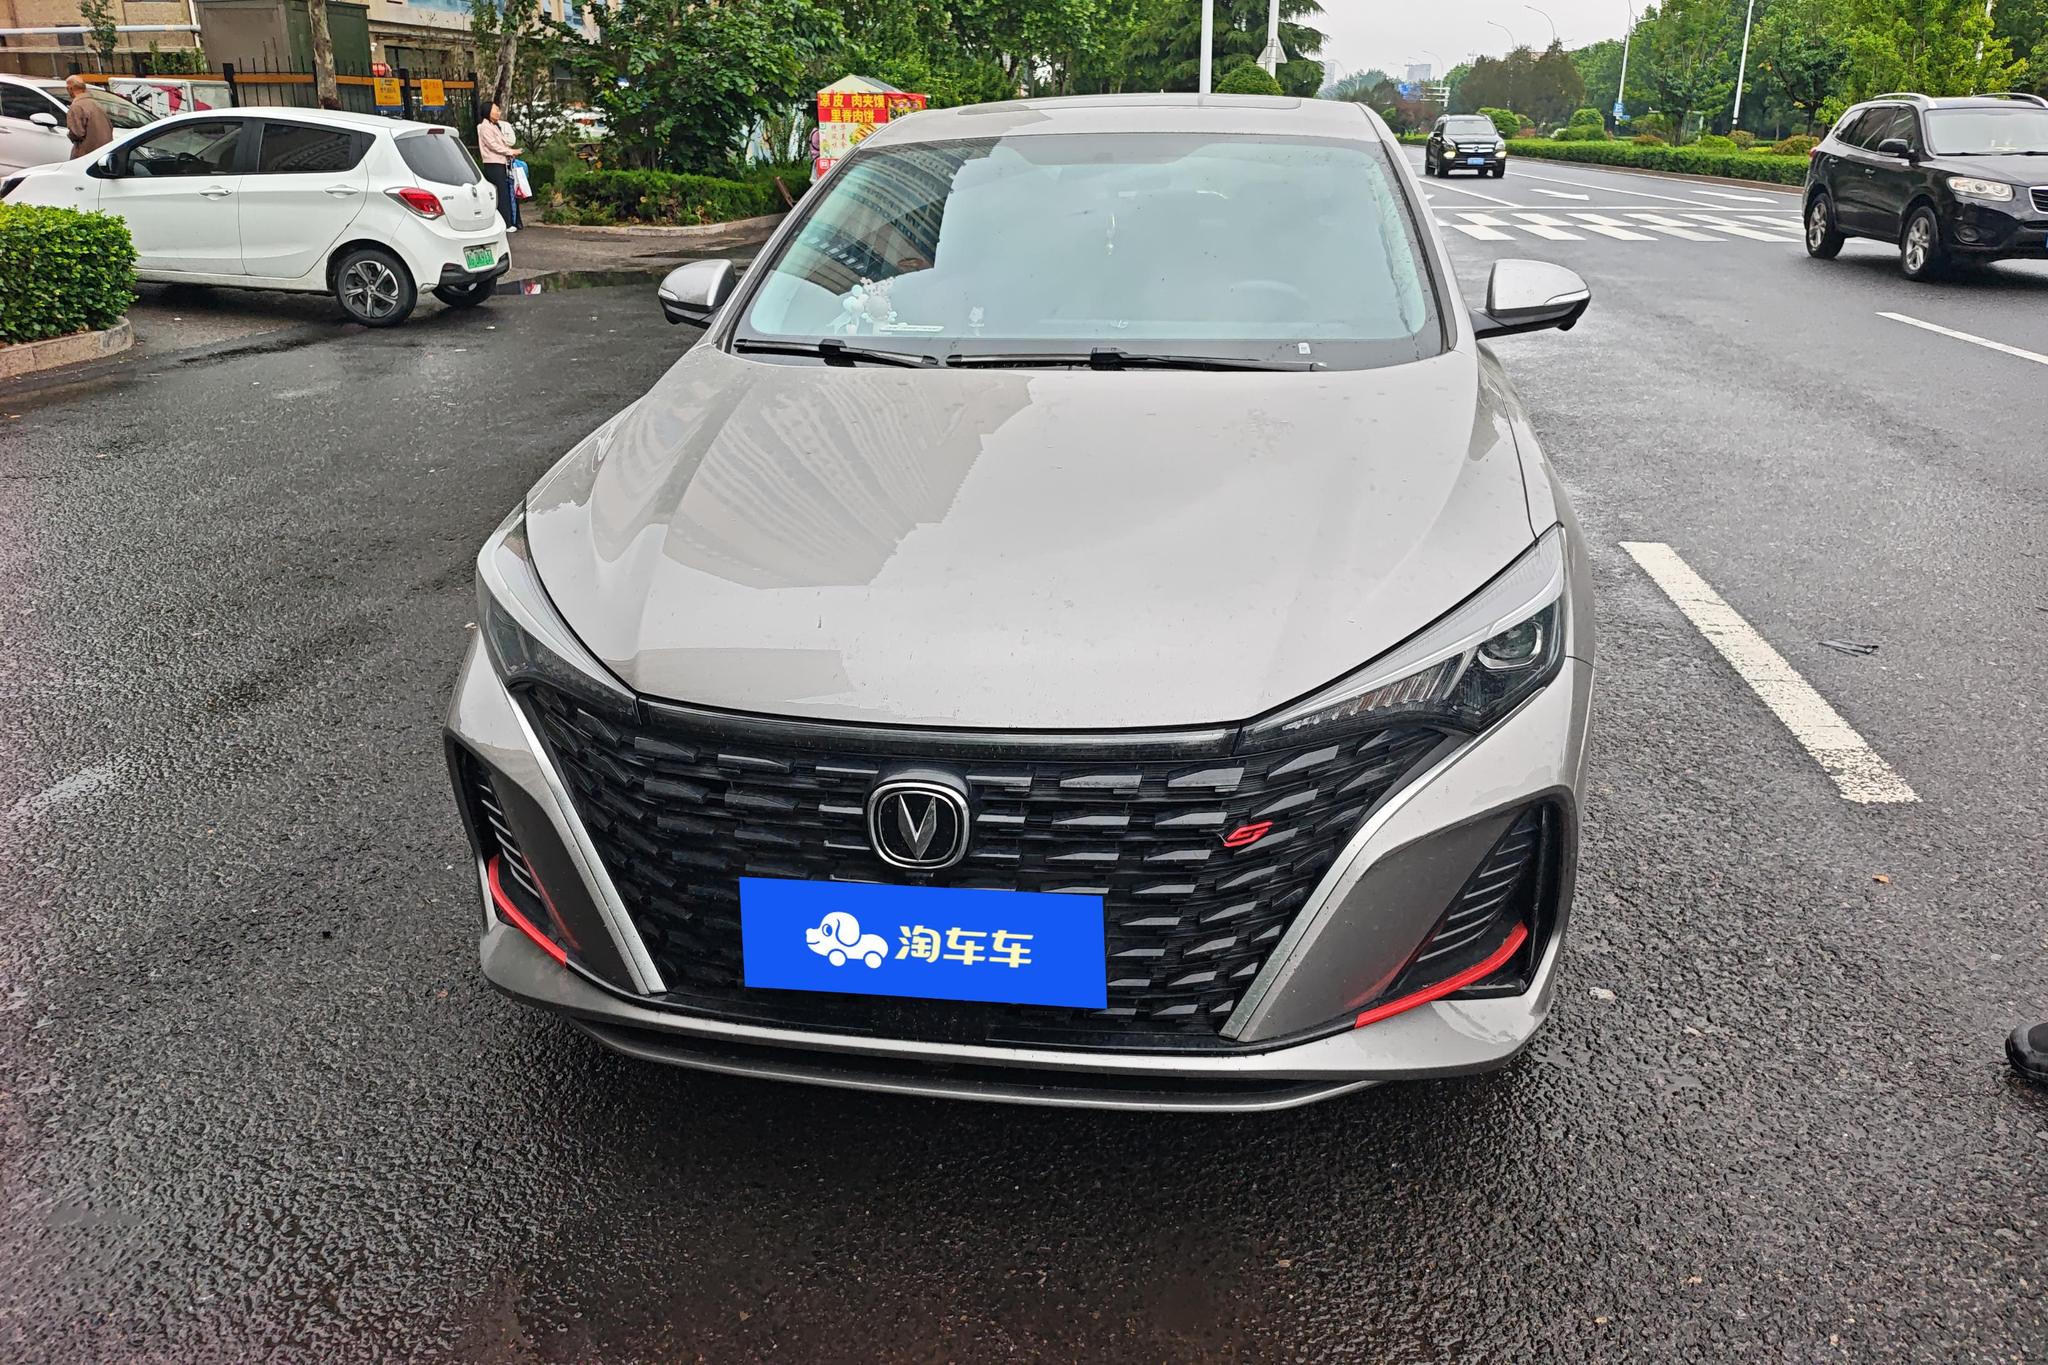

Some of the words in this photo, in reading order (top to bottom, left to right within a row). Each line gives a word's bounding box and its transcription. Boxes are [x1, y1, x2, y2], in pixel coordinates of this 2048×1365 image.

[819, 93, 843, 107] 凉皮
[851, 93, 885, 108] 肉夹馍
[830, 109, 874, 123] 里脊肉饼
